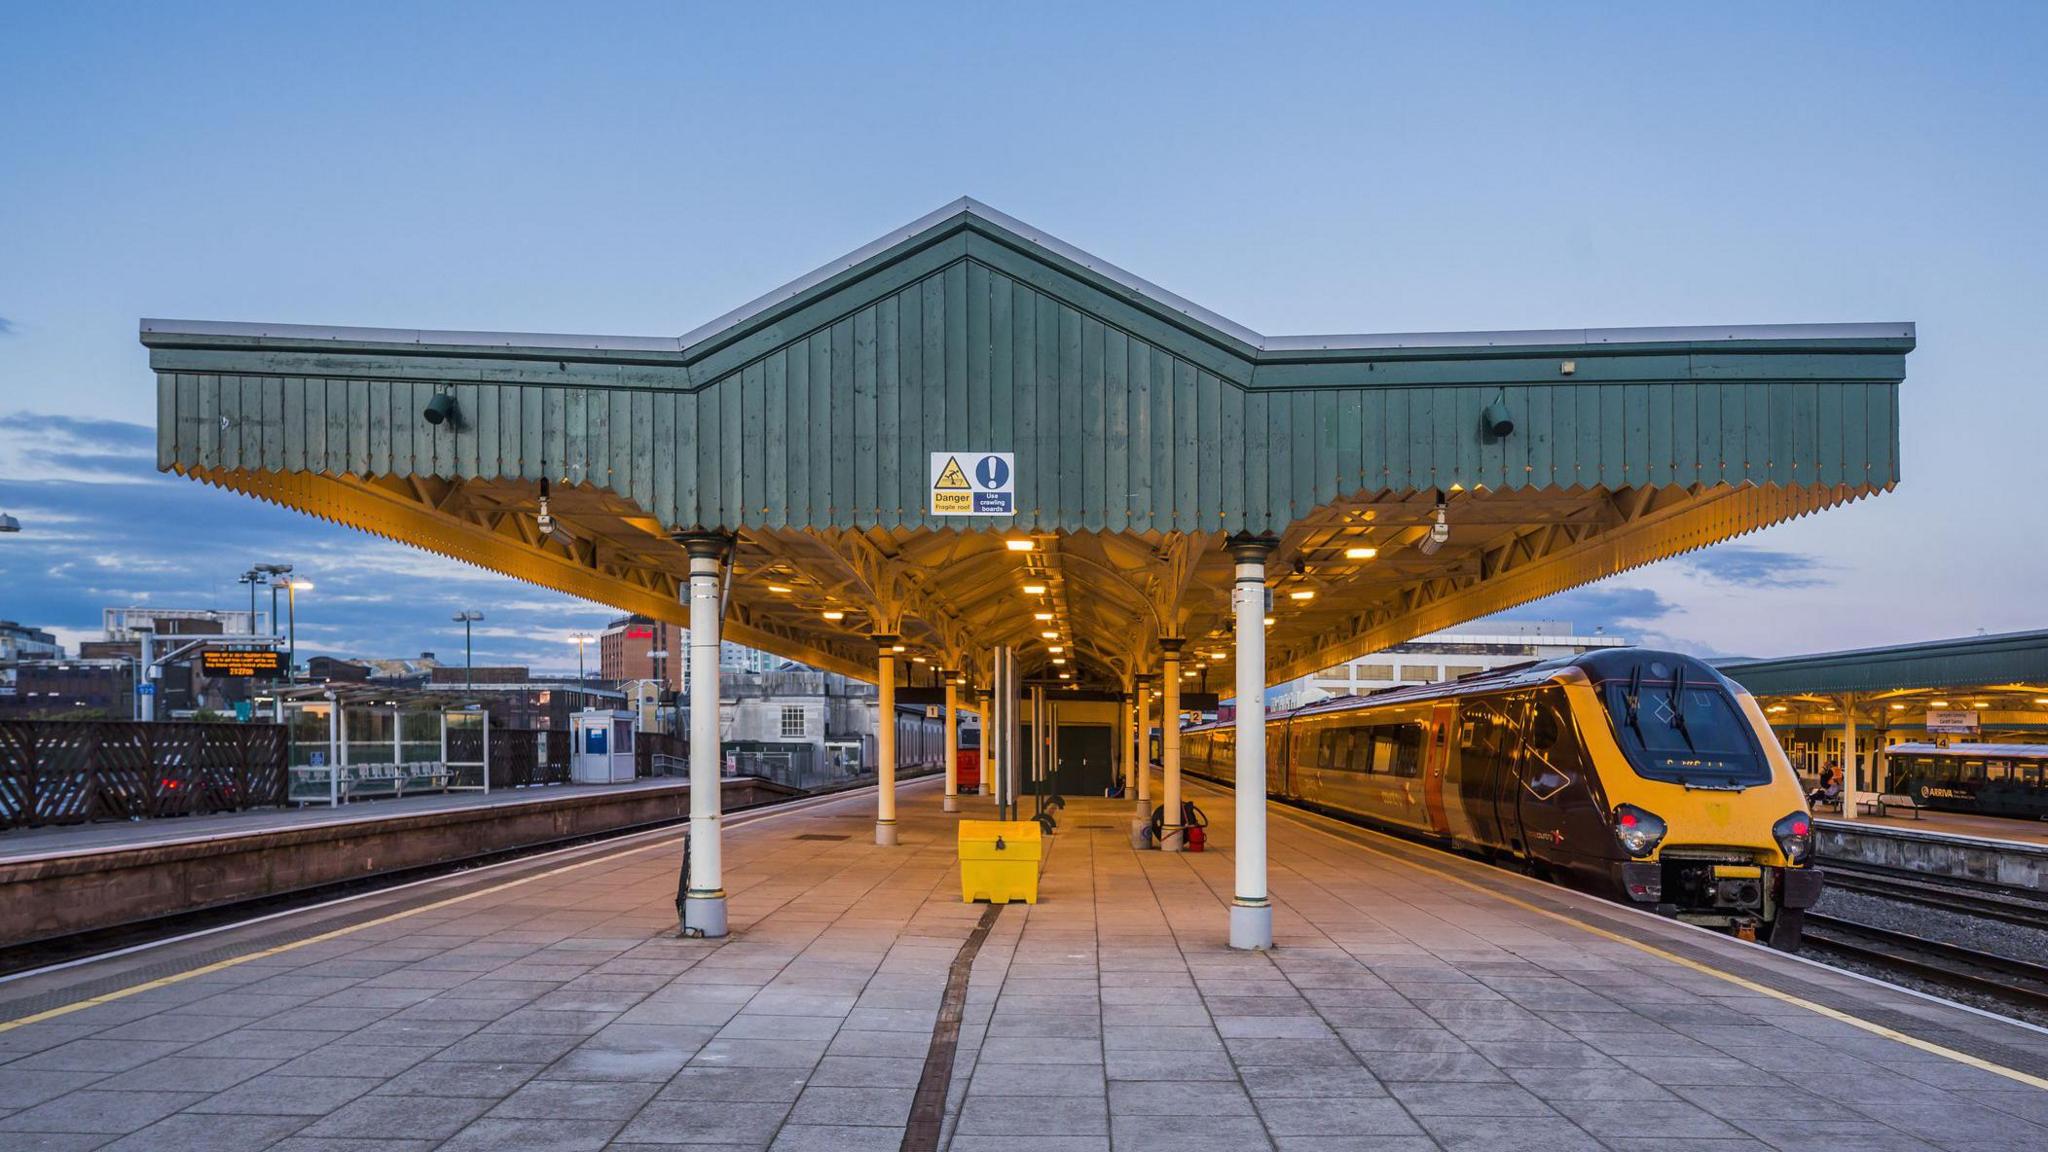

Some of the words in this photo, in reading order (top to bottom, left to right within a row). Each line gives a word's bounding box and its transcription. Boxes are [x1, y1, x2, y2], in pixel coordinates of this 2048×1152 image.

[935, 493, 970, 503] Danger
[1193, 712, 1200, 721] 2
[1938, 738, 1947, 748] 4
[1929, 787, 1954, 798] ARRIVA
